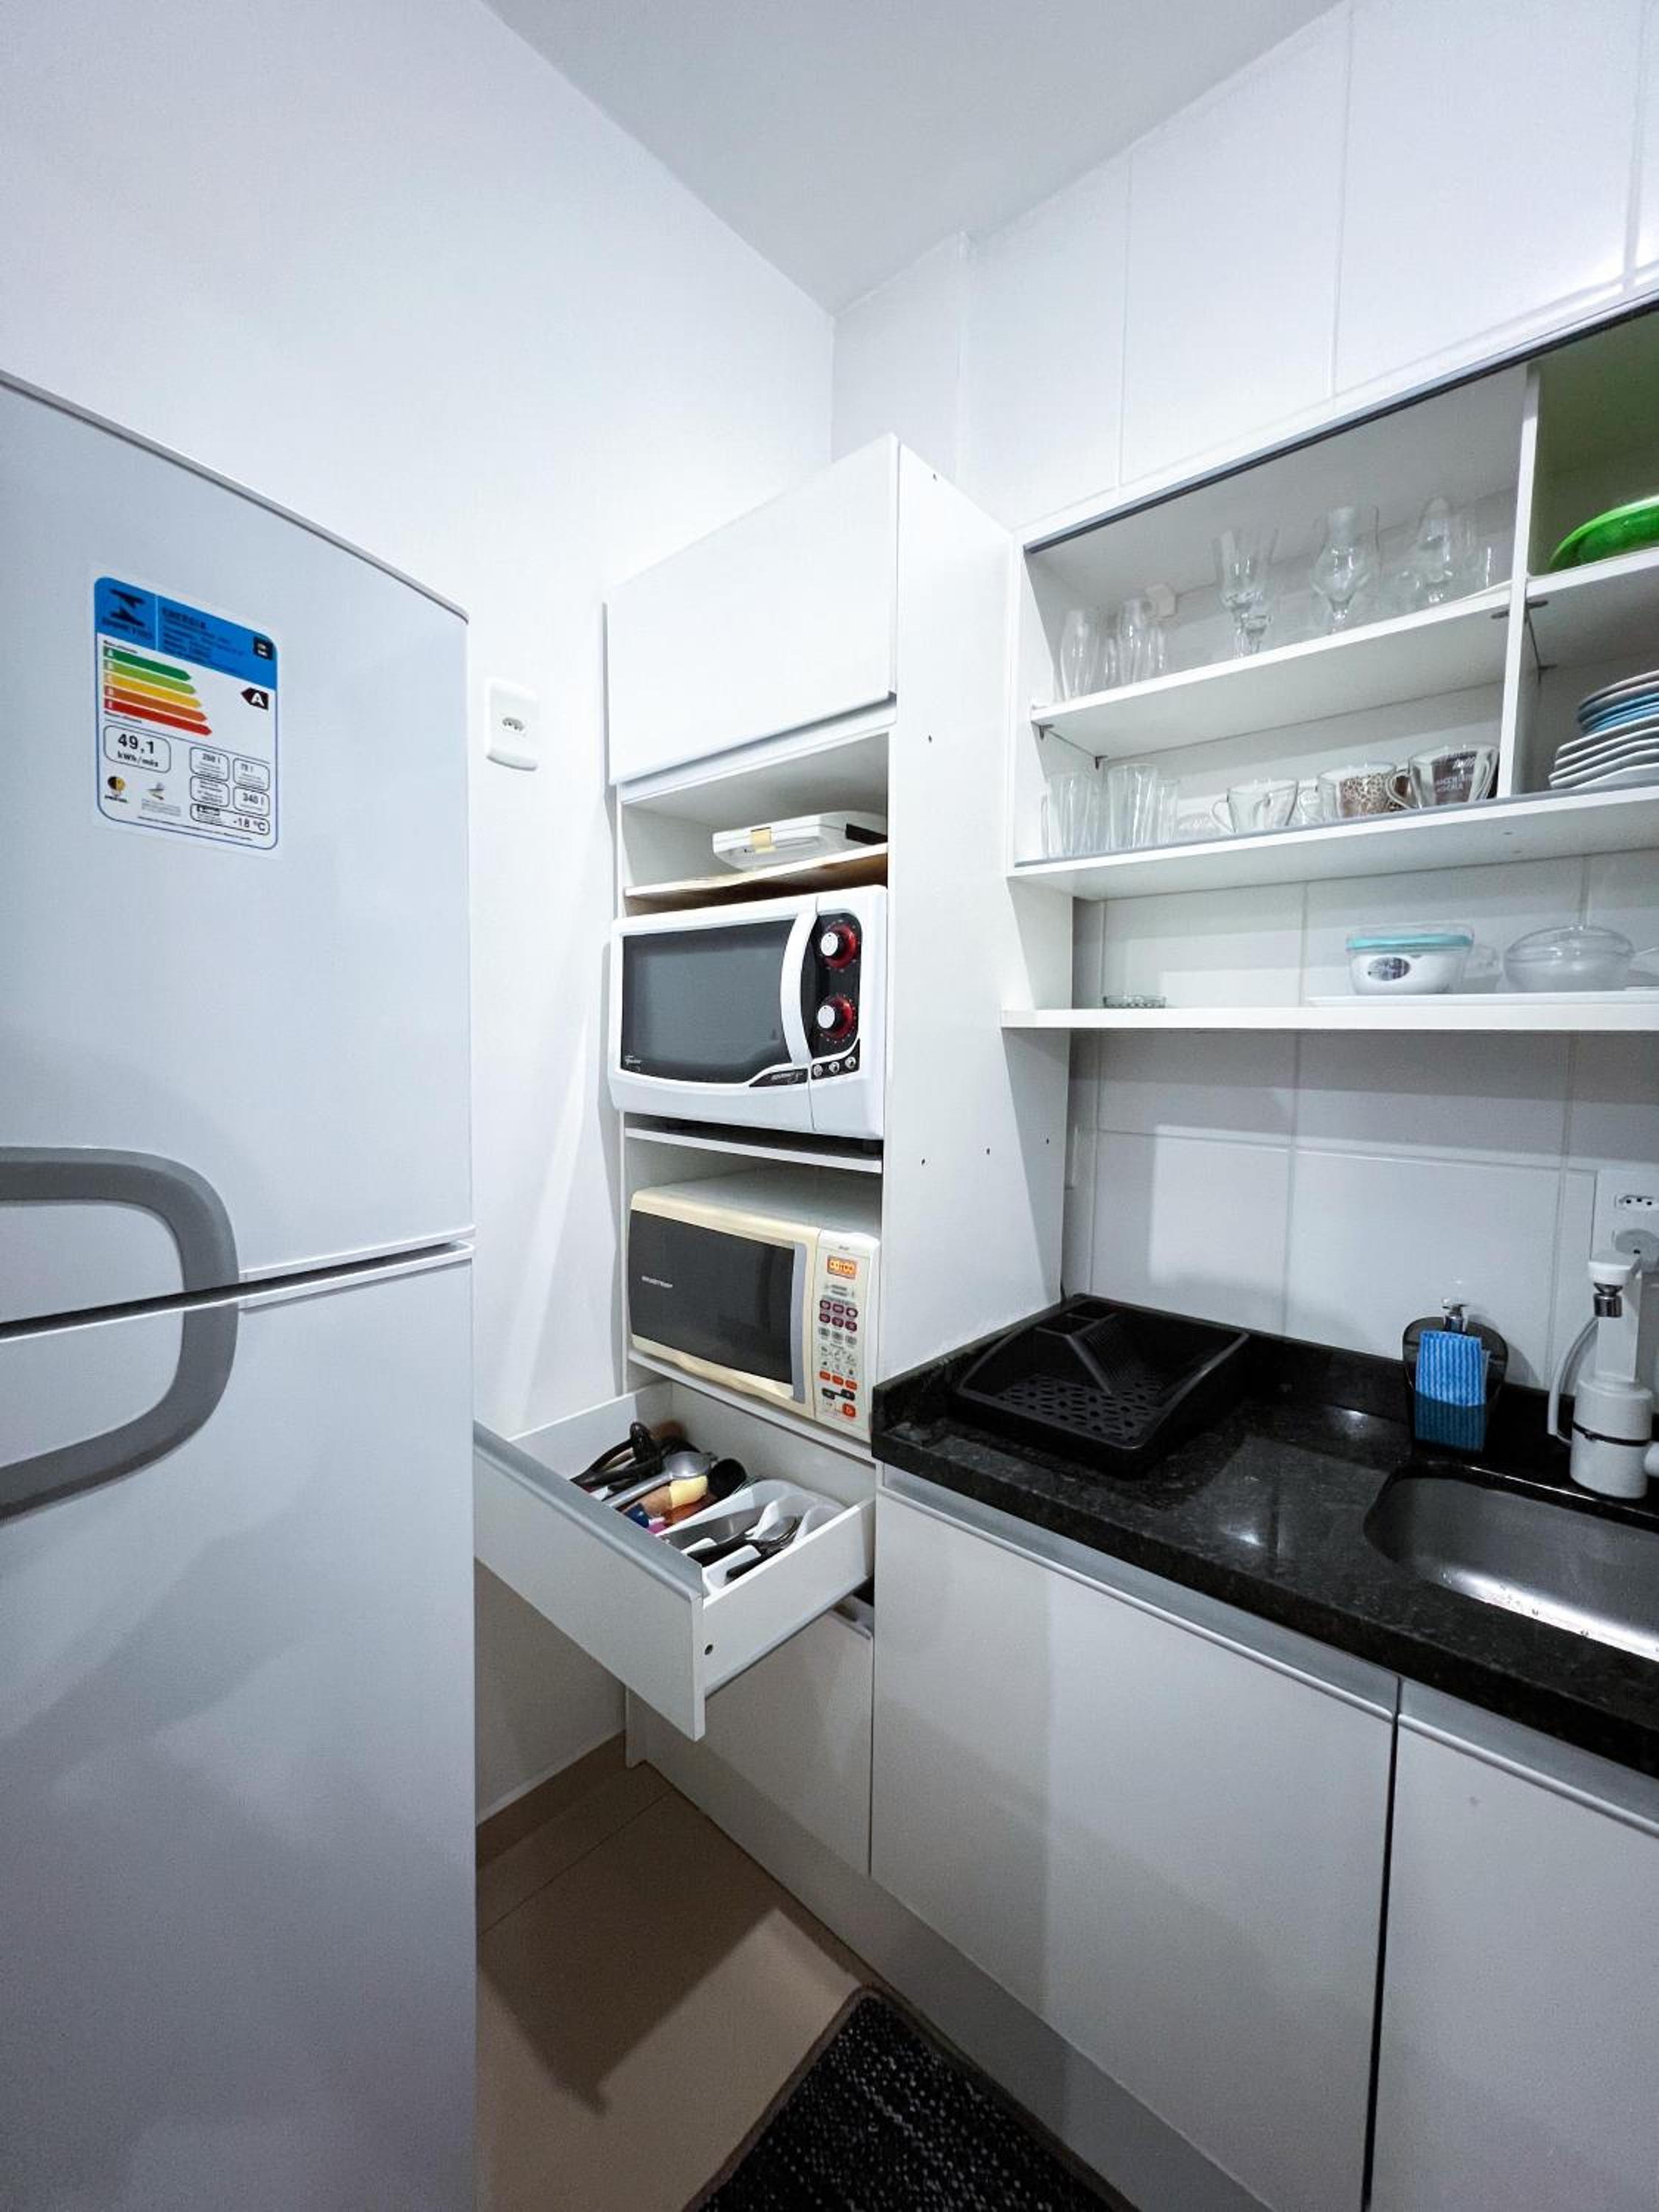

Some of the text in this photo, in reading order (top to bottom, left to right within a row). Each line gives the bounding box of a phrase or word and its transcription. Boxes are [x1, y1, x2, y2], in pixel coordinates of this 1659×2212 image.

[251, 692, 265, 706] A
[118, 734, 153, 754] 49,1
[233, 817, 250, 828] -18
[253, 820, 265, 832] °C
